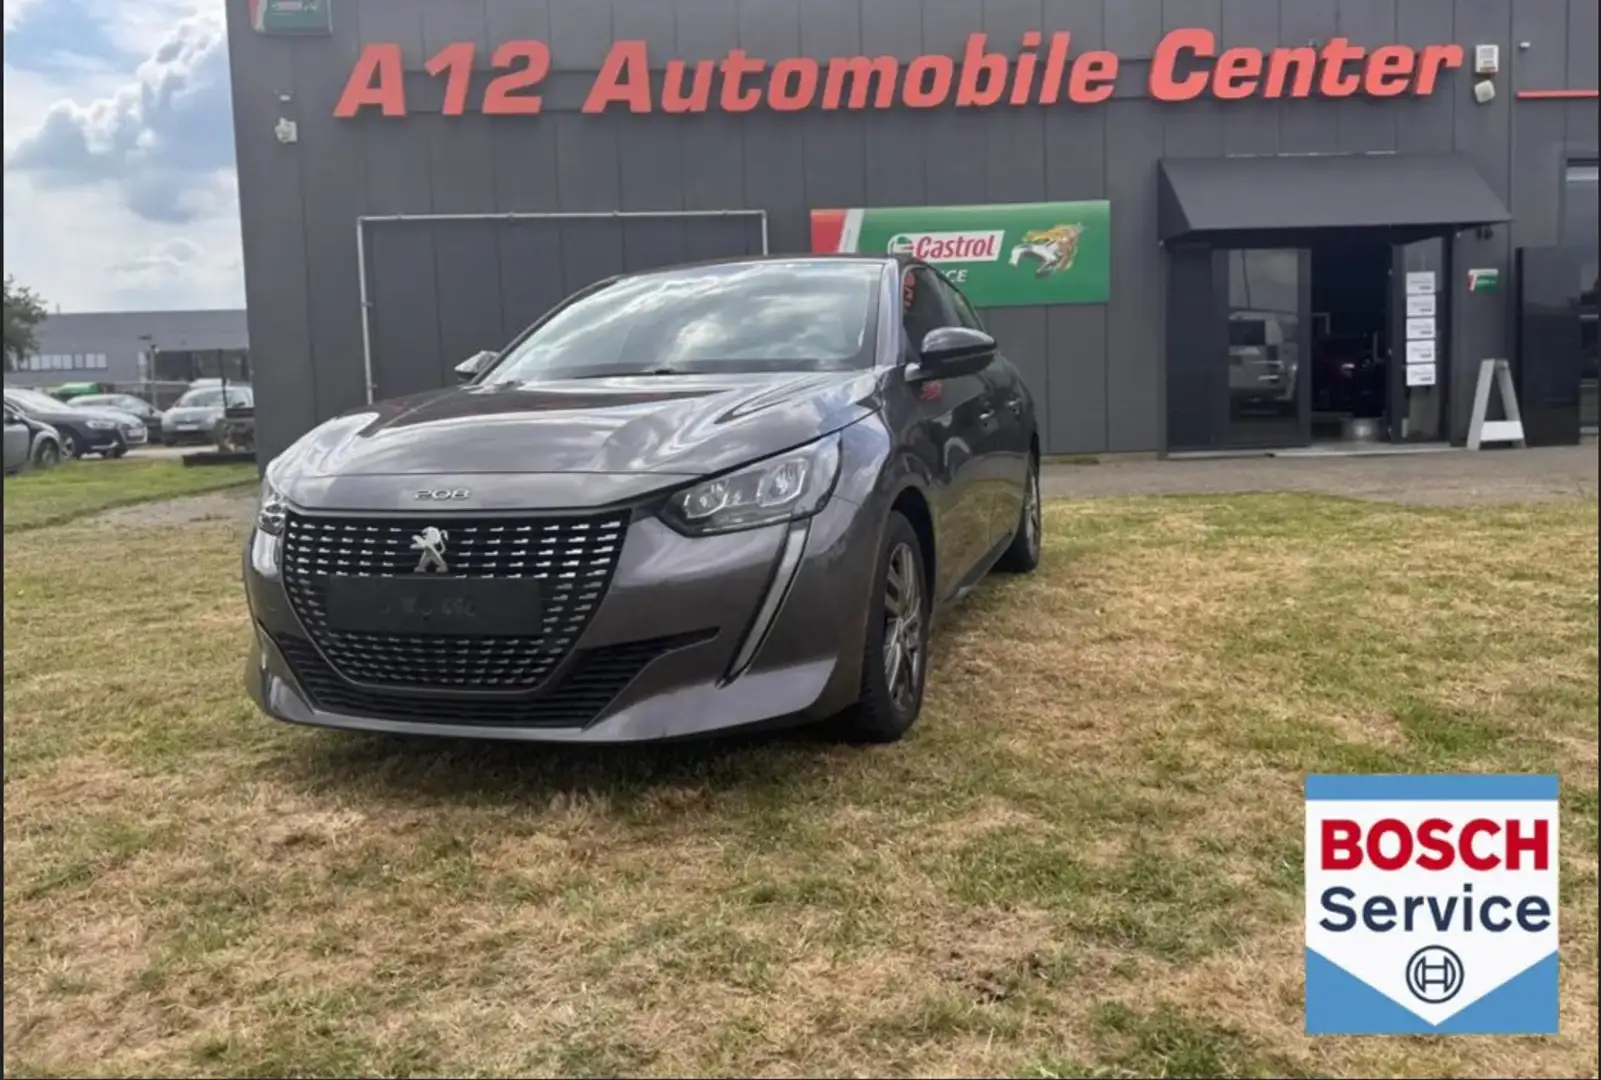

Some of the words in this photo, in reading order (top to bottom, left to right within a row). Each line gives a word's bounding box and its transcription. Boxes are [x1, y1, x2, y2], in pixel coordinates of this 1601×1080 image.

[334, 40, 550, 118] A12
[582, 31, 1120, 114] Automobile
[1148, 28, 1465, 101] Center
[915, 235, 995, 259] Castrol
